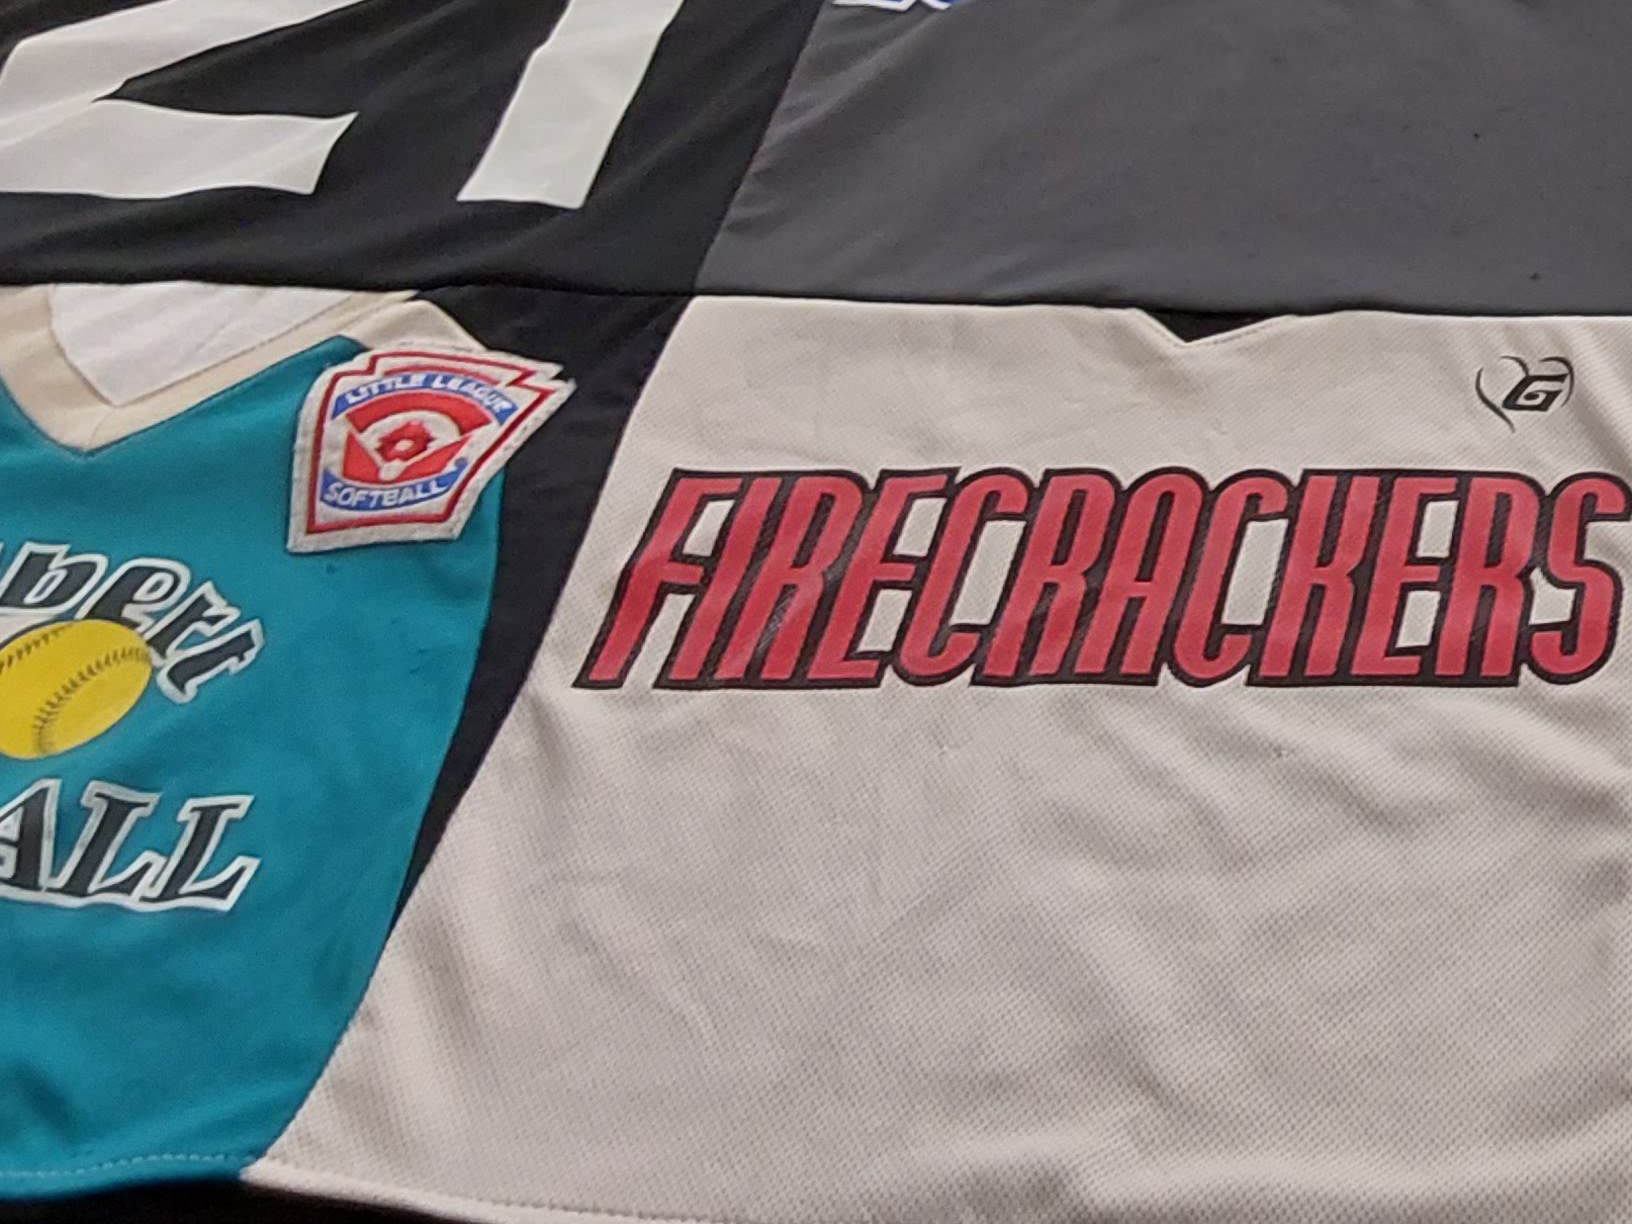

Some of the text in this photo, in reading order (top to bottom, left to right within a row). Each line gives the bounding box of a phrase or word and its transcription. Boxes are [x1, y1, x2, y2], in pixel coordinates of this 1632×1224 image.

[344, 373, 513, 414] LITTLE LEAGUE
[323, 478, 450, 509] SOFTBALL
